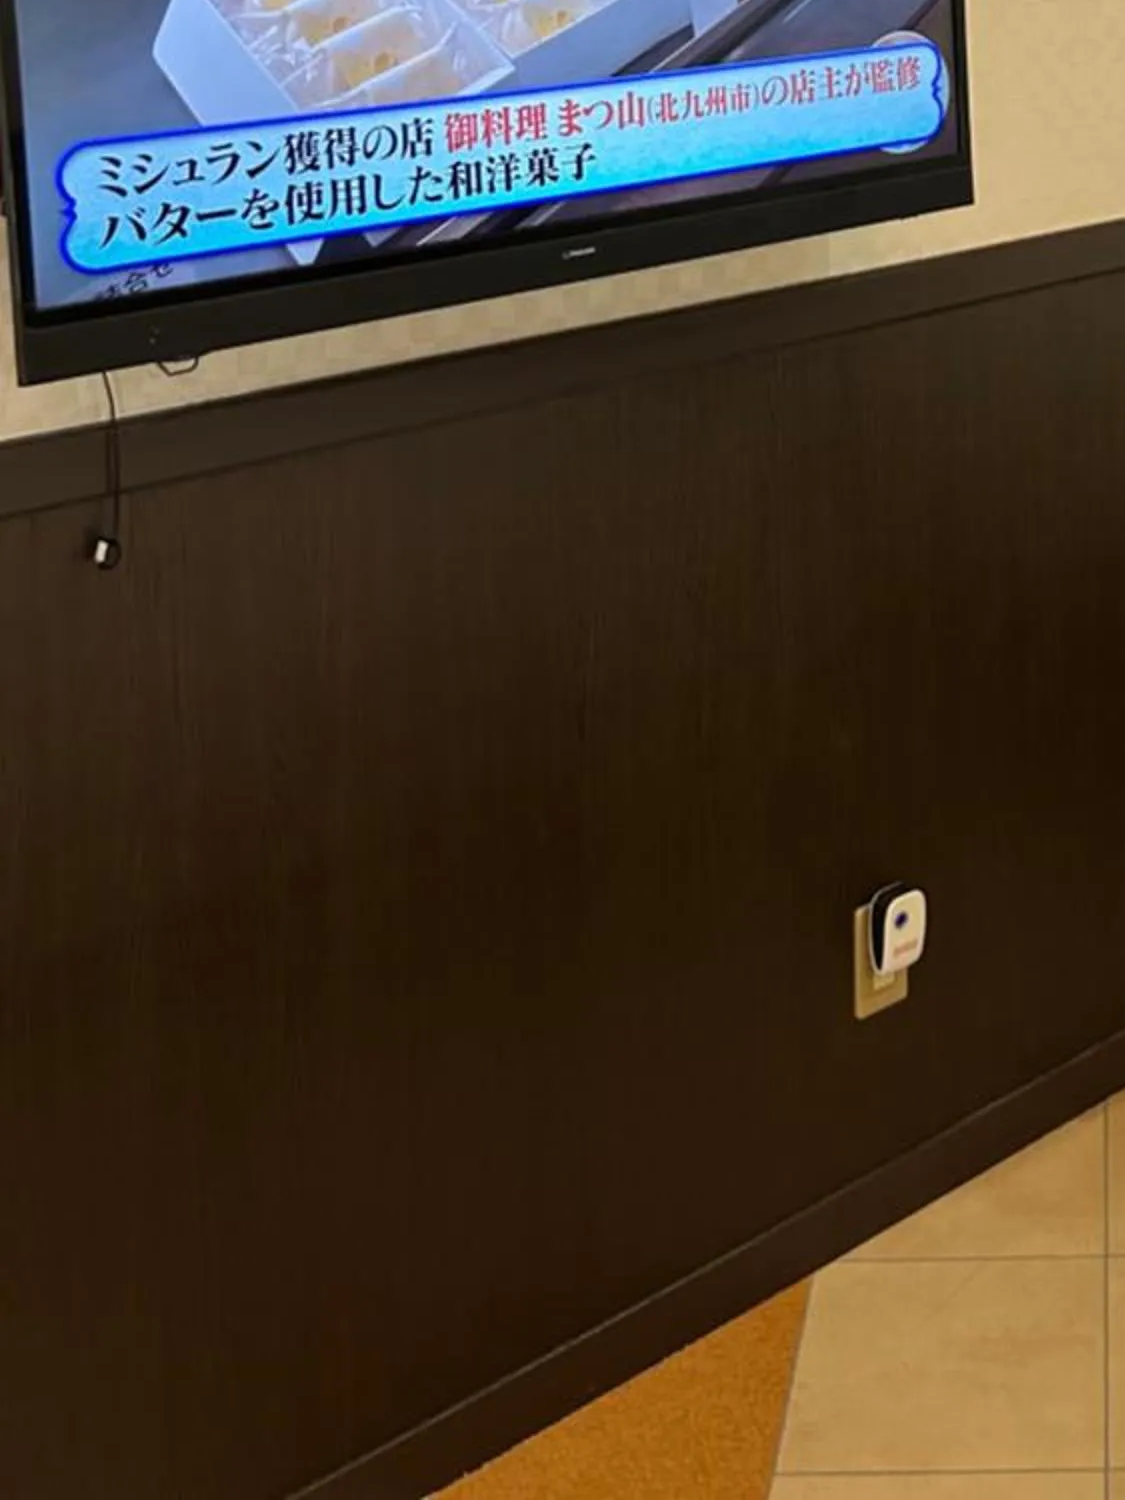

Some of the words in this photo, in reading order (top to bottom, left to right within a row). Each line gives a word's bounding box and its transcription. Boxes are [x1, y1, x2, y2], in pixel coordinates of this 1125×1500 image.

[100, 142, 596, 247] バターを使用した和洋菓子
